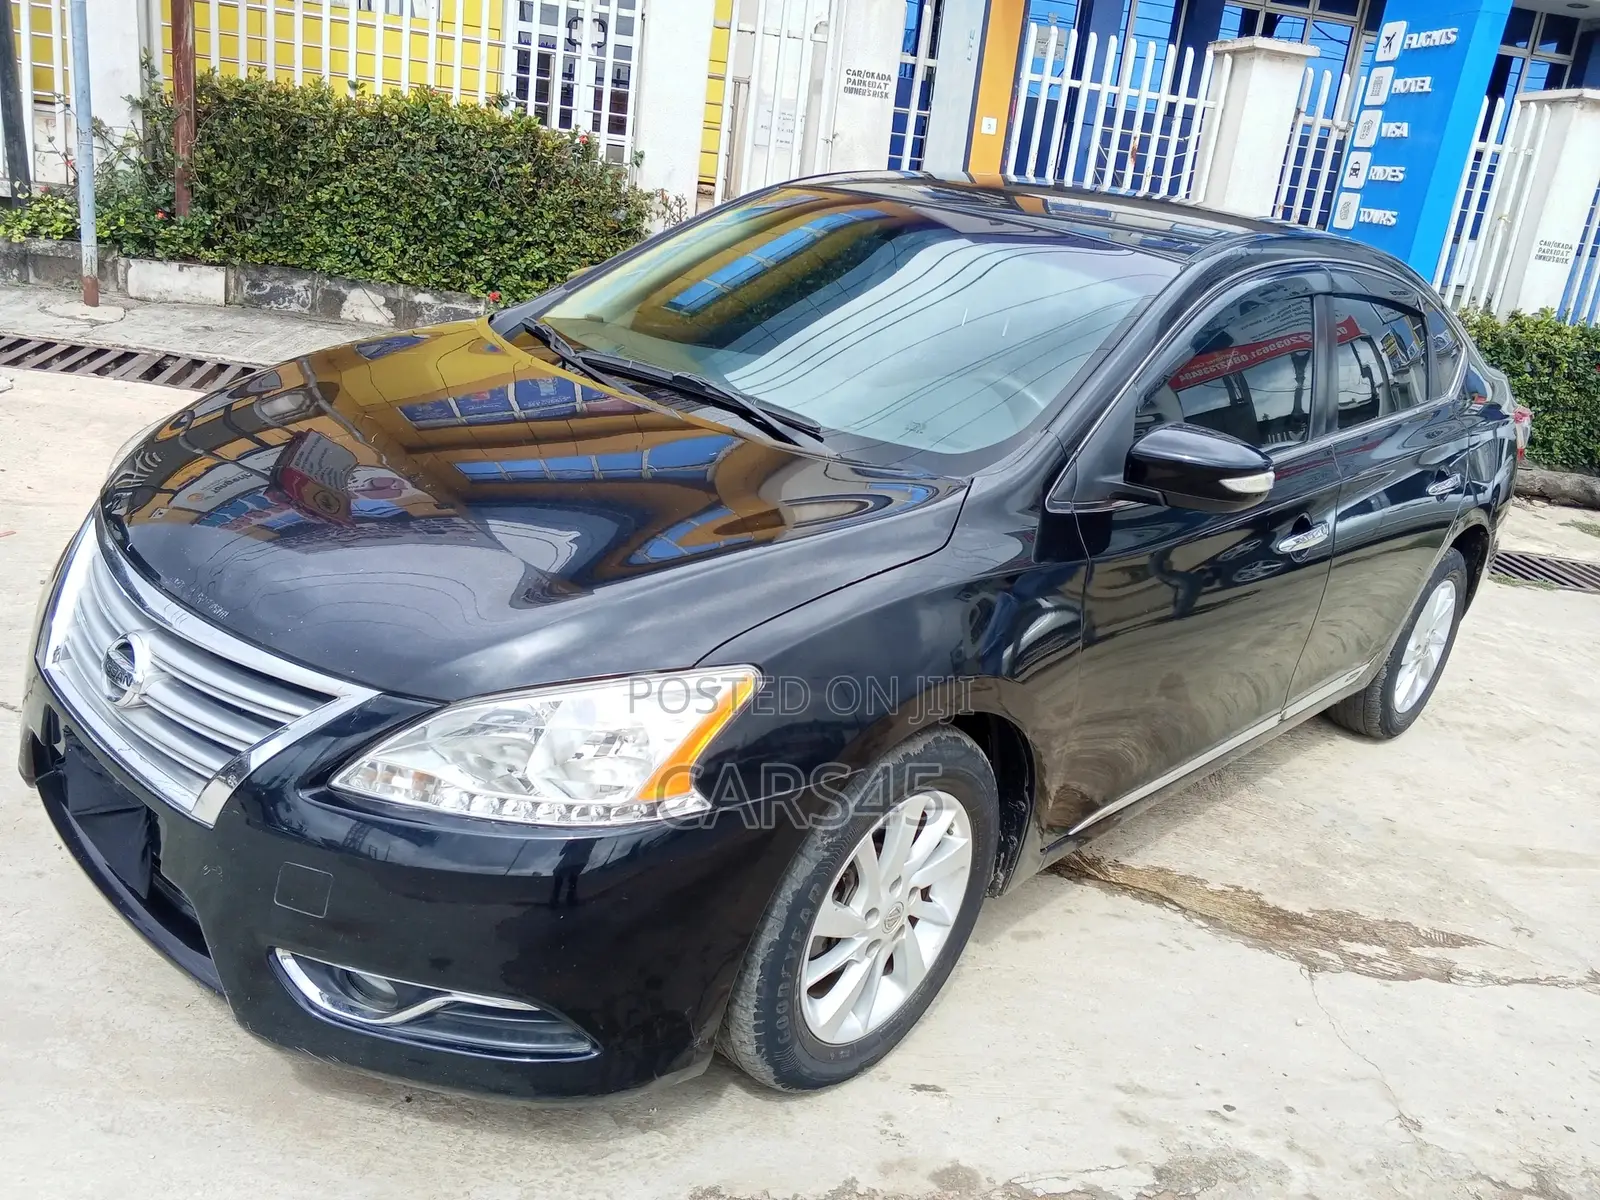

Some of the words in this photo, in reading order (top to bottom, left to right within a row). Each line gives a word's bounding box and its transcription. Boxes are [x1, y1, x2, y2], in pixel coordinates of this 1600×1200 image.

[1404, 28, 1458, 49] FLIGHTS
[846, 68, 892, 82] CAR/OKADA
[1392, 77, 1432, 93] HOTEL
[1381, 122, 1409, 138] VISA
[1368, 166, 1406, 182] RIDES
[1359, 208, 1398, 226] TOURS
